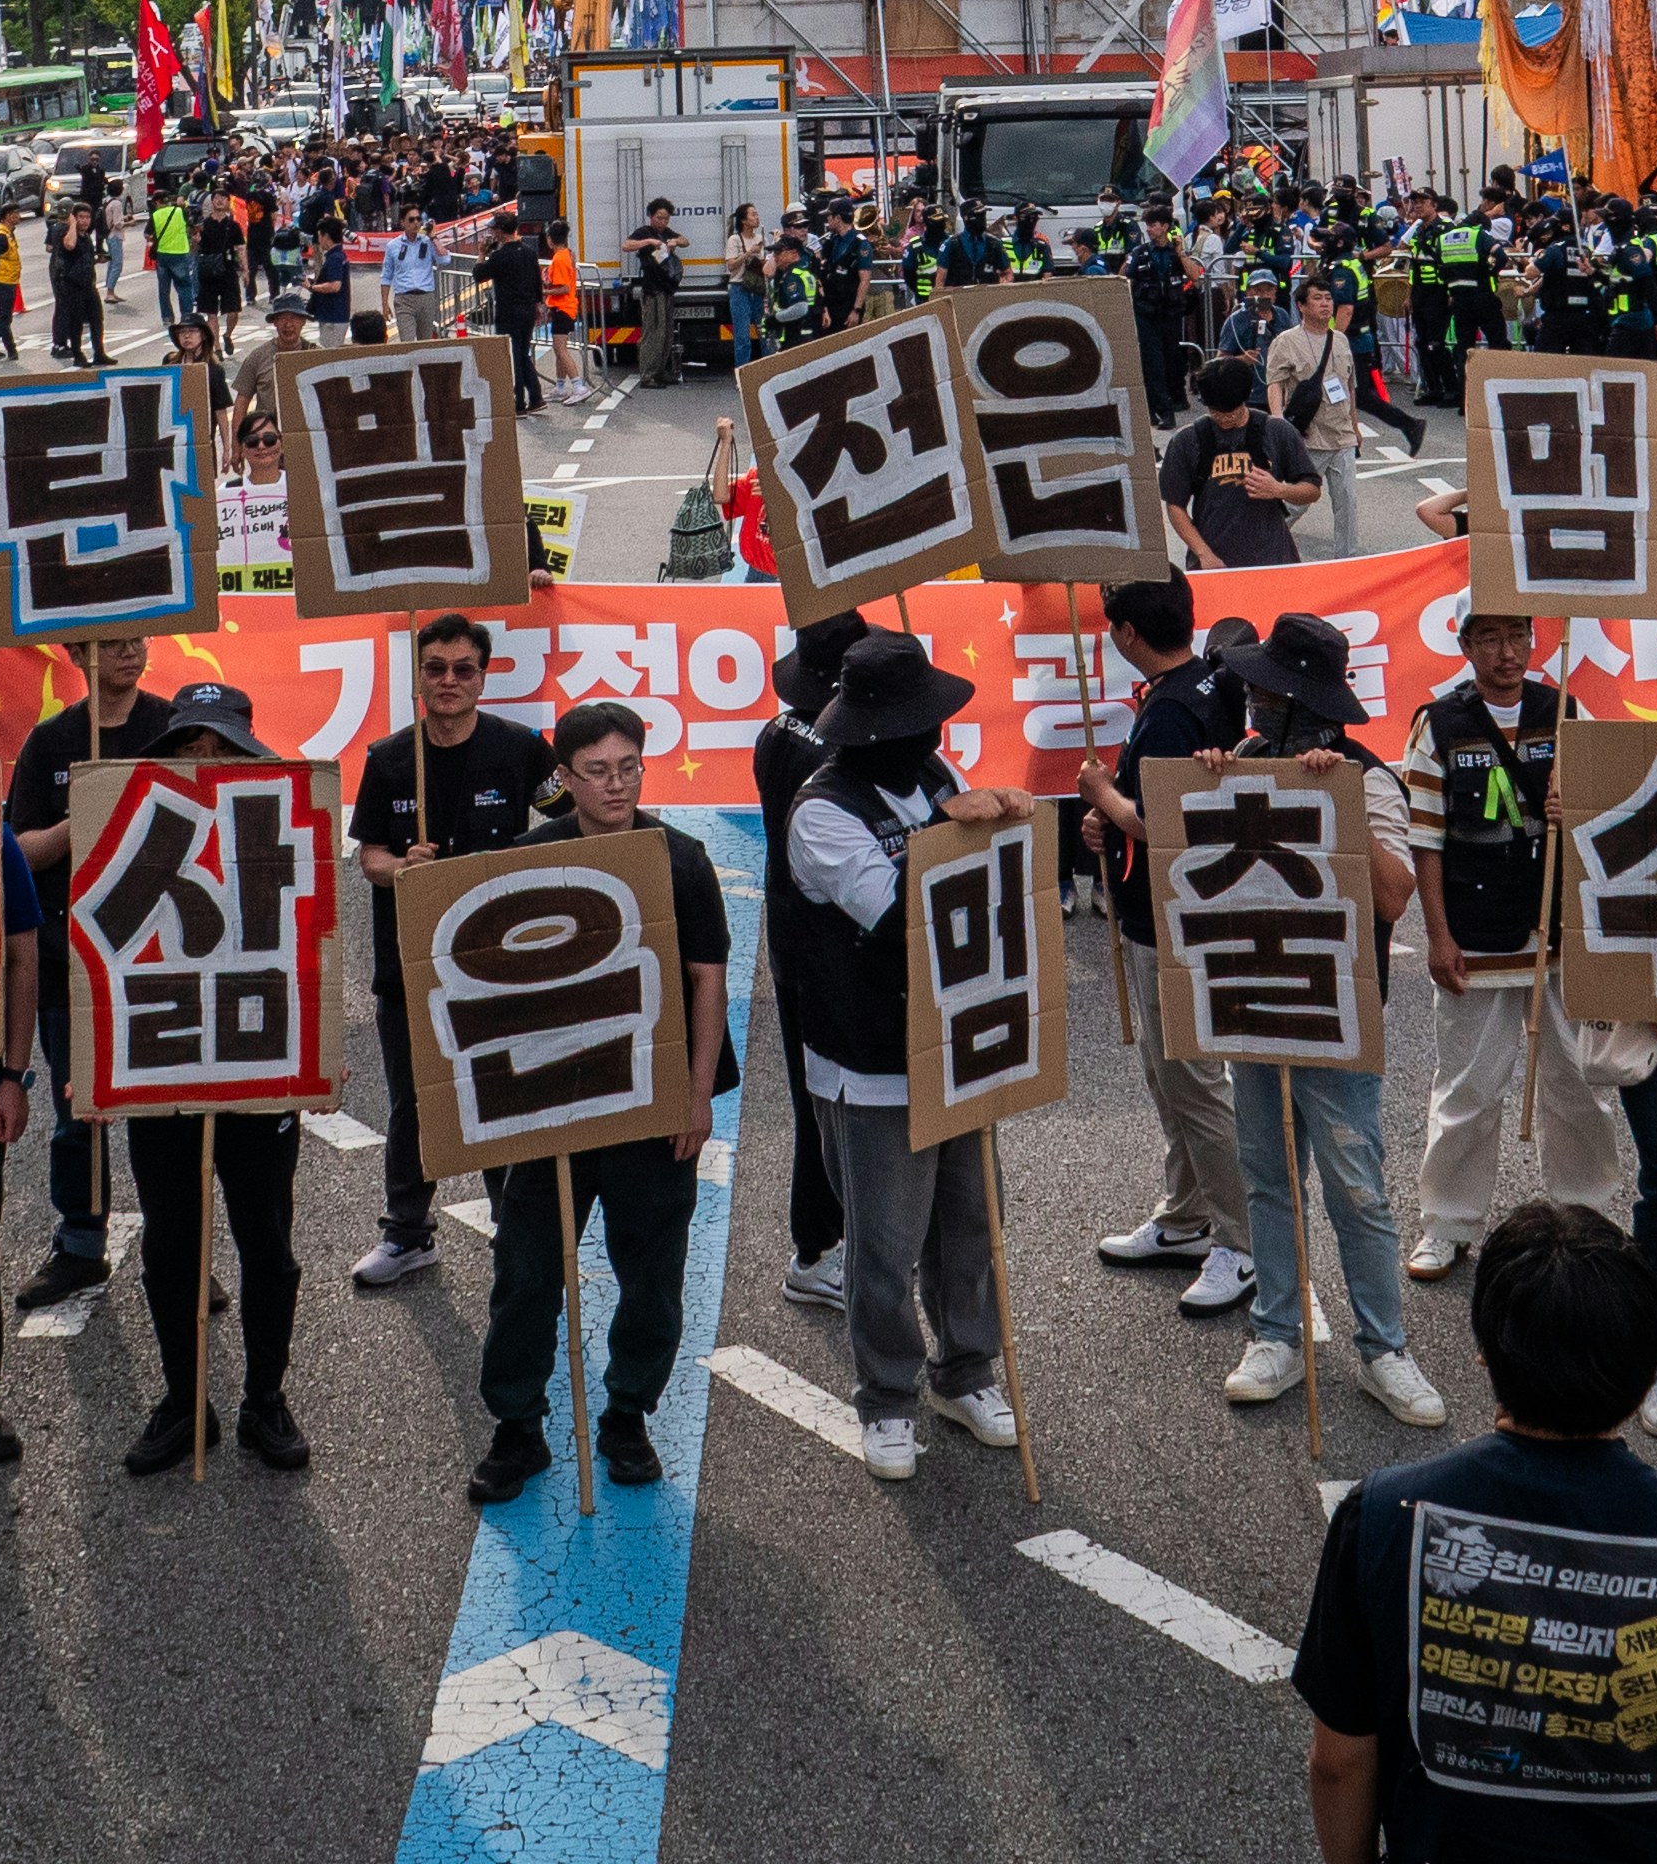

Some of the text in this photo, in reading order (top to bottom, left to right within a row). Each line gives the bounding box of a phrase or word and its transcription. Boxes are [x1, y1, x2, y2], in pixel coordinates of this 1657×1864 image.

[646, 206, 722, 217] UNDAI
[298, 346, 493, 591] 발
[760, 305, 975, 586] 전
[963, 300, 1141, 554] 은
[1485, 370, 1649, 594] 멈
[524, 502, 566, 528] 등과
[1457, 753, 1473, 767] 단결
[71, 762, 339, 1108] 삶
[920, 823, 1039, 1106] 멈
[1165, 775, 1359, 1058] 출
[428, 865, 664, 1142] 은
[1421, 1595, 1528, 1646] 진상규명
[1531, 1617, 1615, 1658] 책임자
[1423, 1536, 1551, 1586] 김충현의
[1420, 1687, 1488, 1726] 발전소
[1544, 1712, 1616, 1744] 총고용
[1421, 1643, 1511, 1689] 위험의
[1513, 1663, 1610, 1705] 외주화
[1435, 1751, 1504, 1773] 공공운수노조
